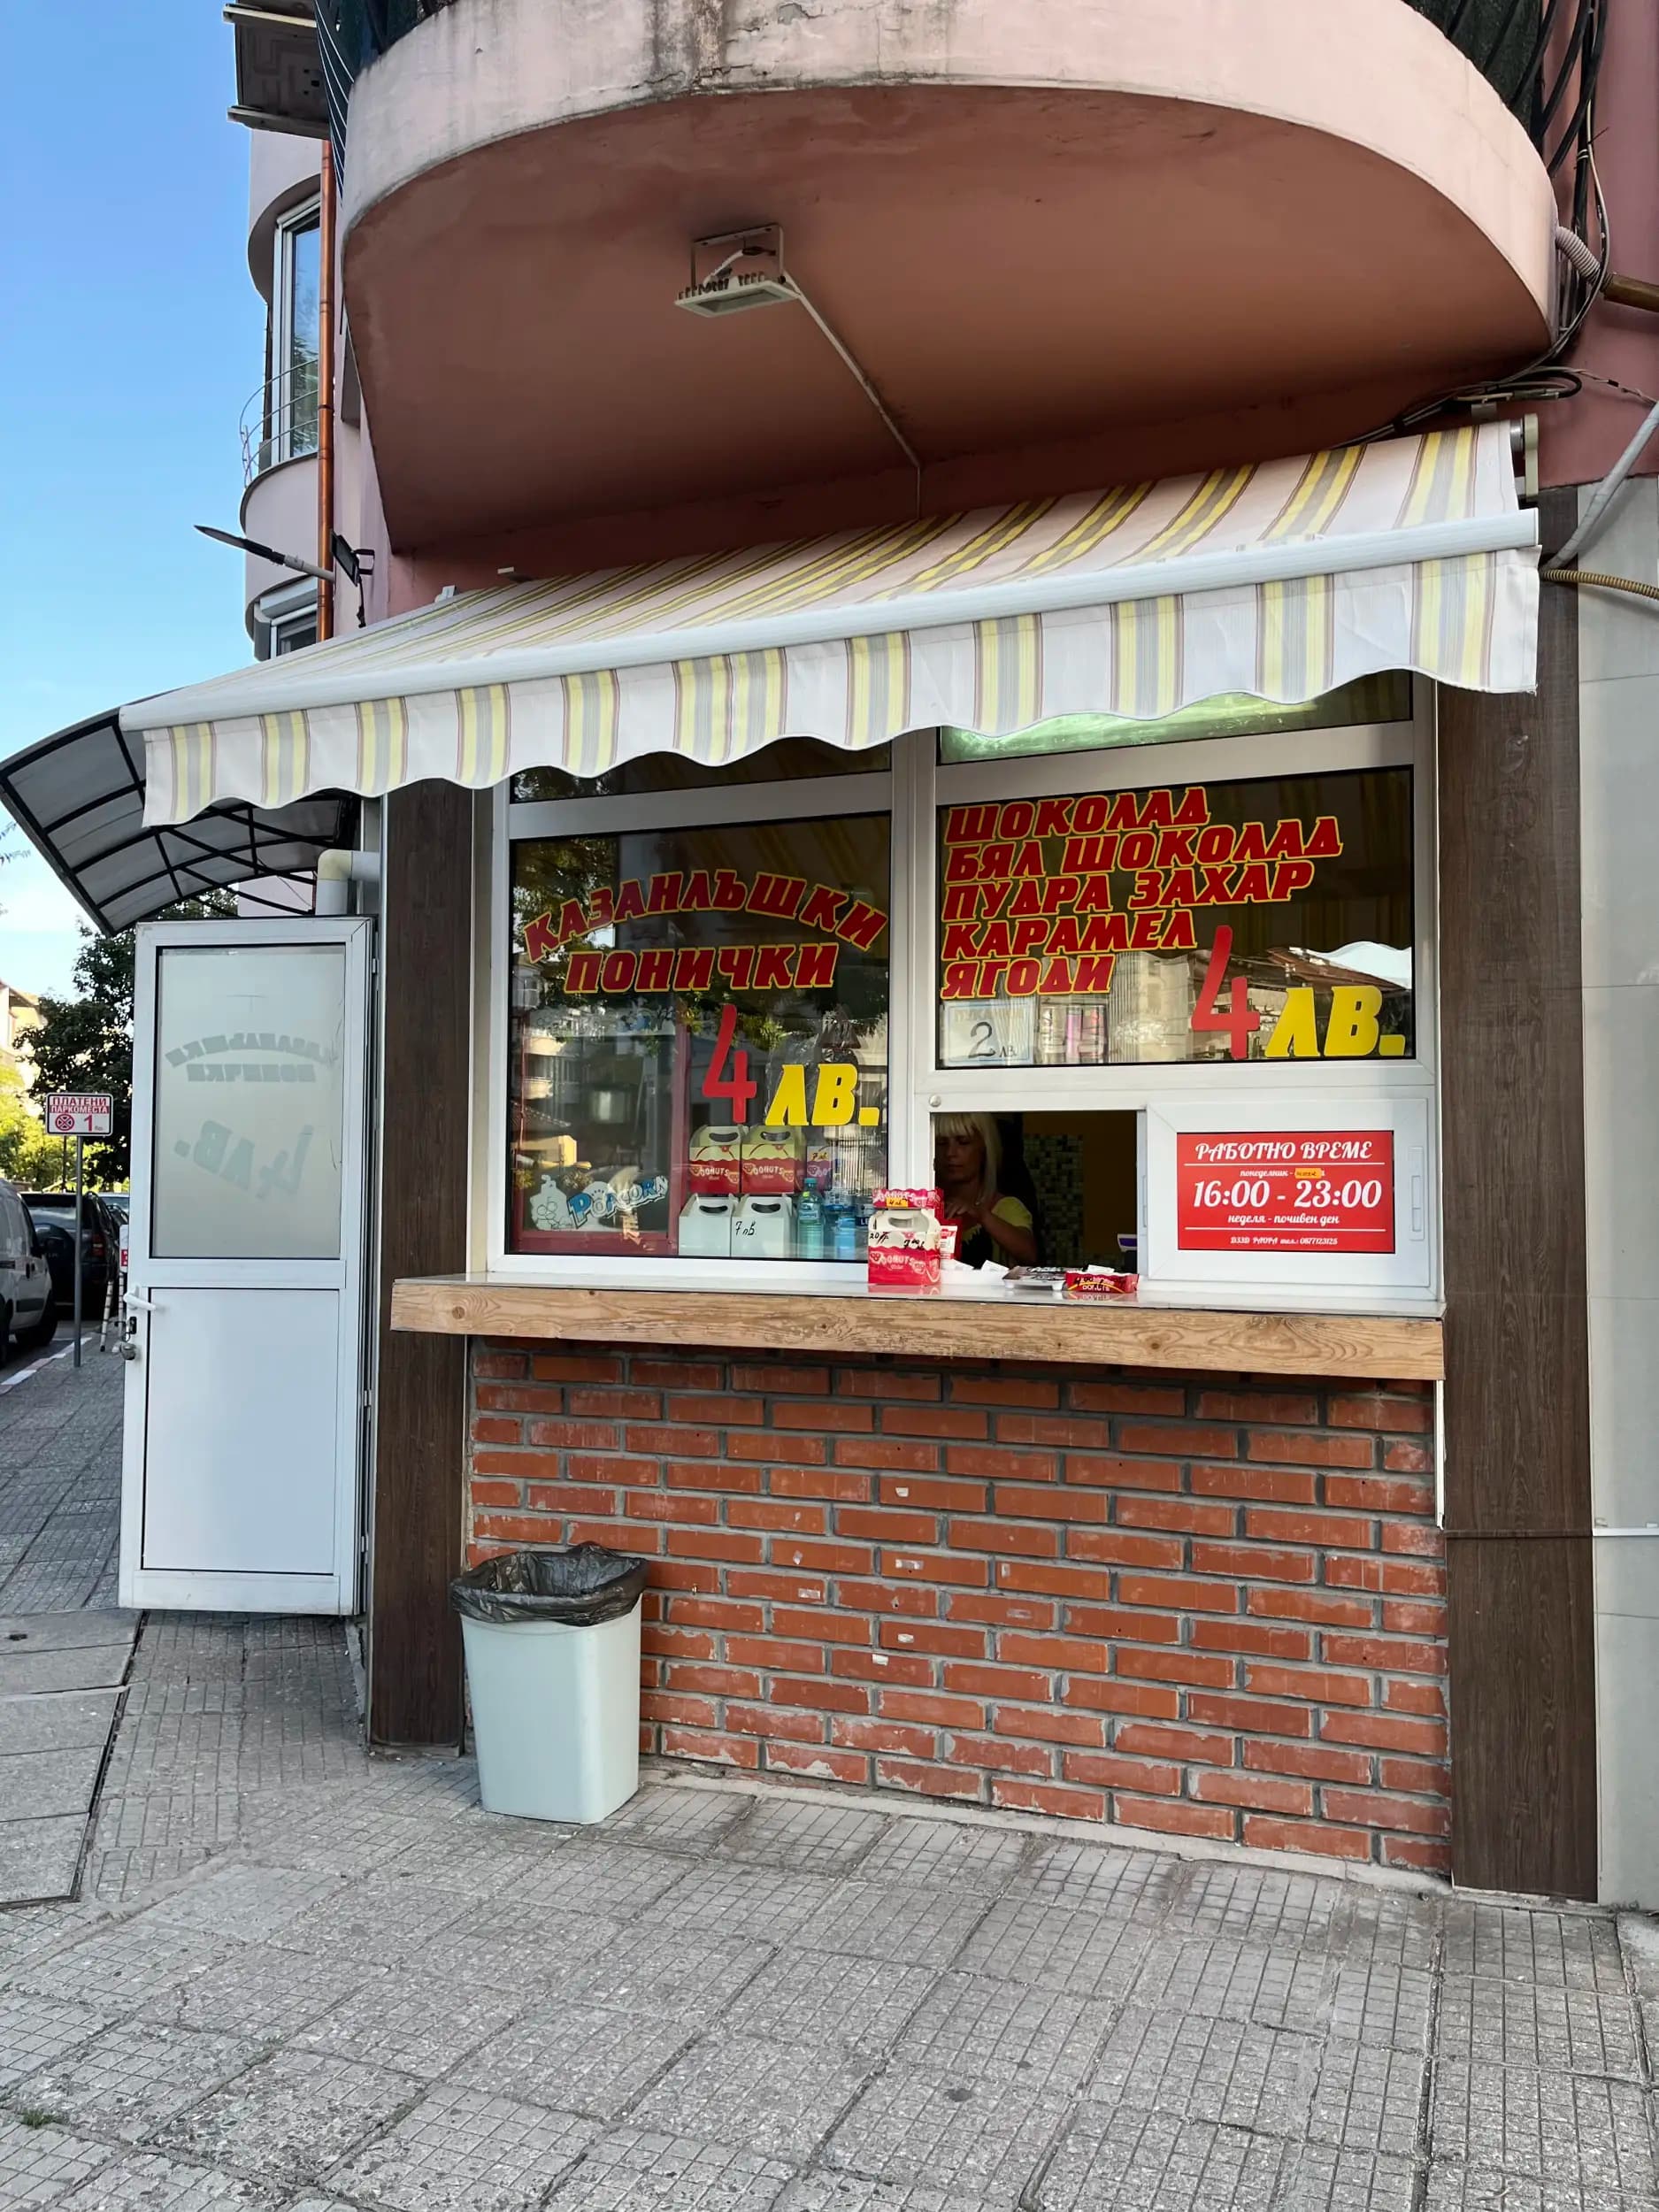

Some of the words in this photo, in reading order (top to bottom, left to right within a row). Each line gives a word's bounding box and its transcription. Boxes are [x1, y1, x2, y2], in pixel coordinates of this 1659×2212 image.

[944, 787, 1210, 844] ШОКОЛАД
[945, 840, 1046, 883] БЯЛ
[1061, 816, 1343, 874] ШОКОЛАД
[942, 874, 1112, 921] ПУДРА
[1128, 860, 1315, 910] ЗАХАР
[524, 869, 888, 964] КАЗАНЛЪШКИ
[941, 909, 1197, 960] КАРАМЕЛ
[563, 942, 839, 994] ПОНИЧКИ
[940, 954, 1116, 999] ЯГОДИ
[1191, 926, 1260, 1060] 4
[1265, 986, 1406, 1058] ЛВ.
[968, 1021, 996, 1058] 2
[702, 1003, 757, 1123] 4
[764, 1064, 880, 1125] ЛВ.
[84, 1114, 92, 1132] 1
[753, 1165, 785, 1176] DONUTS
[1195, 1142, 1296, 1162] РАБОТНО
[1301, 1141, 1372, 1160] ВРЕМЕ
[1240, 1170, 1289, 1179] понеделник
[1194, 1180, 1271, 1208] 16:00
[1294, 1179, 1382, 1209] 23:00
[1228, 1213, 1265, 1226] неделя
[1274, 1212, 1317, 1225] почивен
[1319, 1216, 1340, 1227] ден
